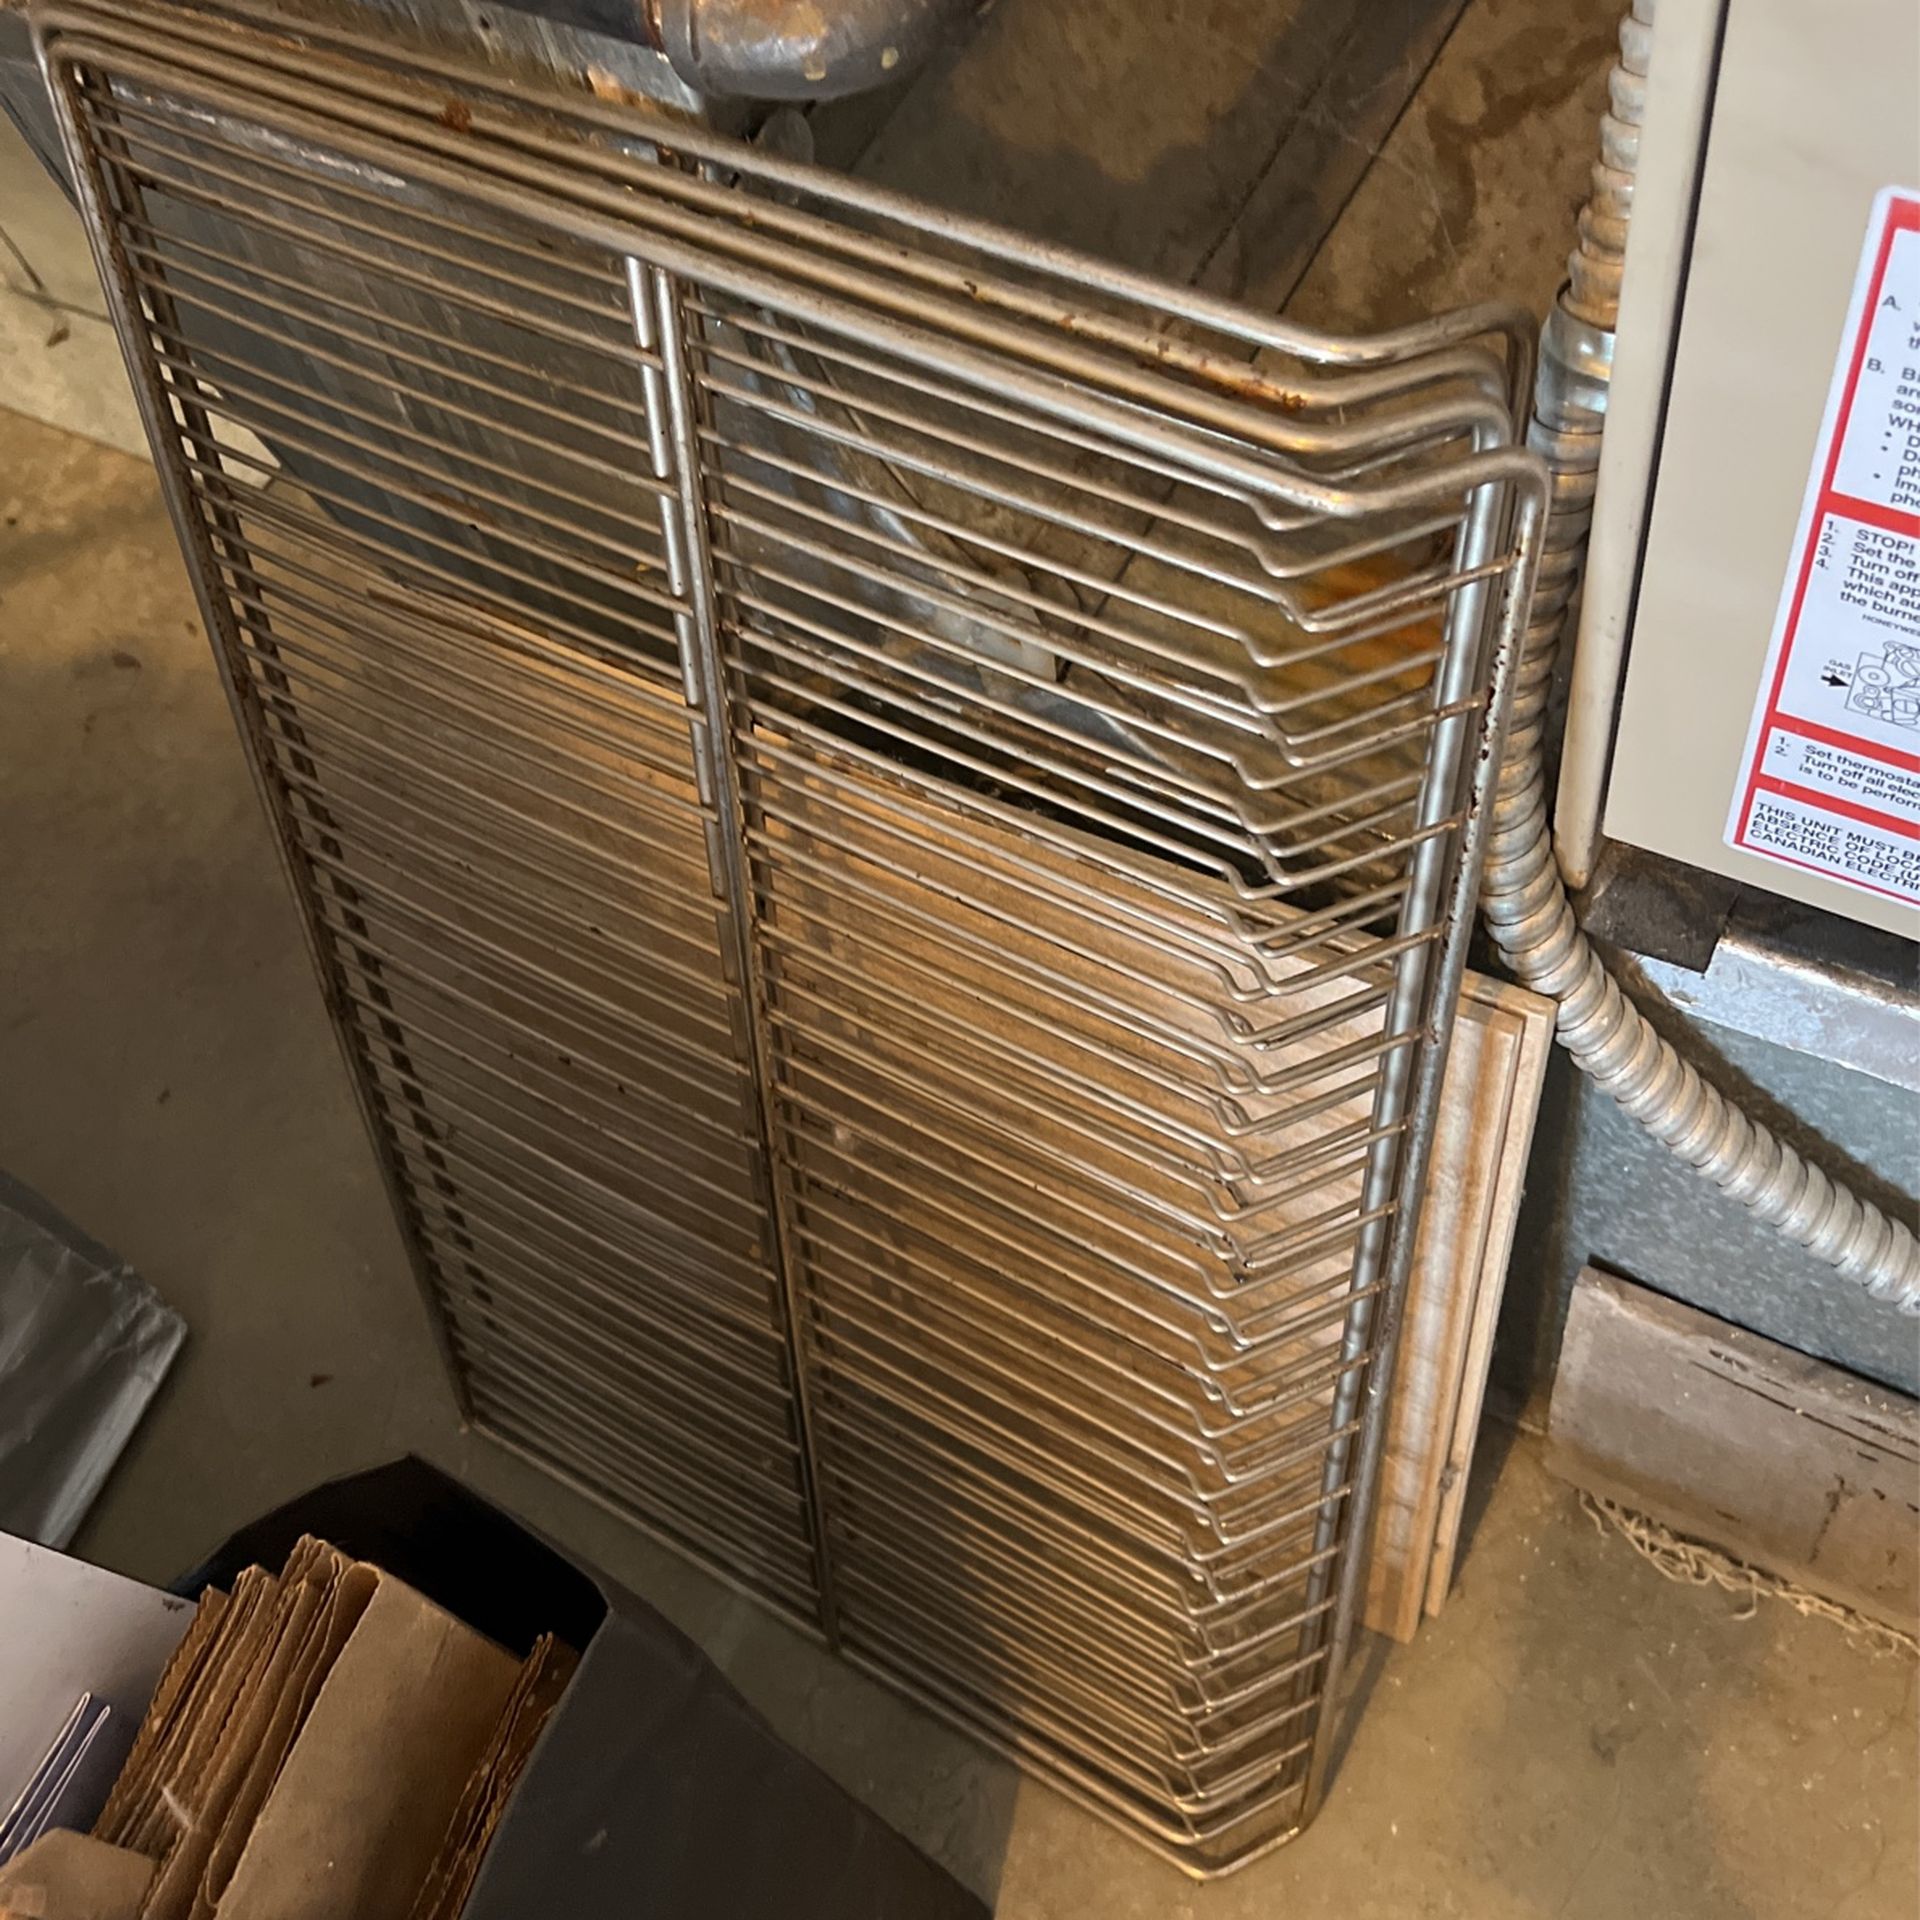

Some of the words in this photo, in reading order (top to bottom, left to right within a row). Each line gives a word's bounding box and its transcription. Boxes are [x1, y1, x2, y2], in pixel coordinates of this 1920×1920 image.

[1867, 357, 1885, 374] B.
[1903, 449, 1920, 464] D
[1894, 476, 1920, 494] Im
[1821, 532, 1835, 545] 2.
[1853, 541, 1882, 559] Set
[1887, 552, 1916, 569] the
[1827, 520, 1838, 533] 1.
[1856, 528, 1915, 555] STOP!
[1815, 558, 1829, 570] 4.
[1848, 565, 1884, 586] This
[1818, 545, 1832, 558] 3.
[1850, 553, 1890, 575] Turn
[1840, 591, 1868, 607] the
[1843, 580, 1895, 603] which
[1822, 665, 1853, 679] INLET
[1828, 659, 1852, 671] GAS
[1779, 736, 1790, 748] 1.
[1804, 744, 1832, 761] Set
[1799, 763, 1812, 775] is
[1818, 769, 1833, 781] to
[1838, 776, 1858, 789] be
[1803, 753, 1838, 773] Turn
[1841, 768, 1863, 780] off
[1866, 776, 1885, 788] all
[1754, 812, 1840, 846] ABSENCE
[1845, 841, 1871, 853] OF
[1757, 802, 1796, 821] THIS
[1801, 817, 1843, 835] UNIT
[1846, 831, 1899, 854] MUST
[1750, 829, 1841, 864] CANADIAN
[1752, 820, 1839, 854] ELECTRIC
[1844, 850, 1896, 873] CODE
